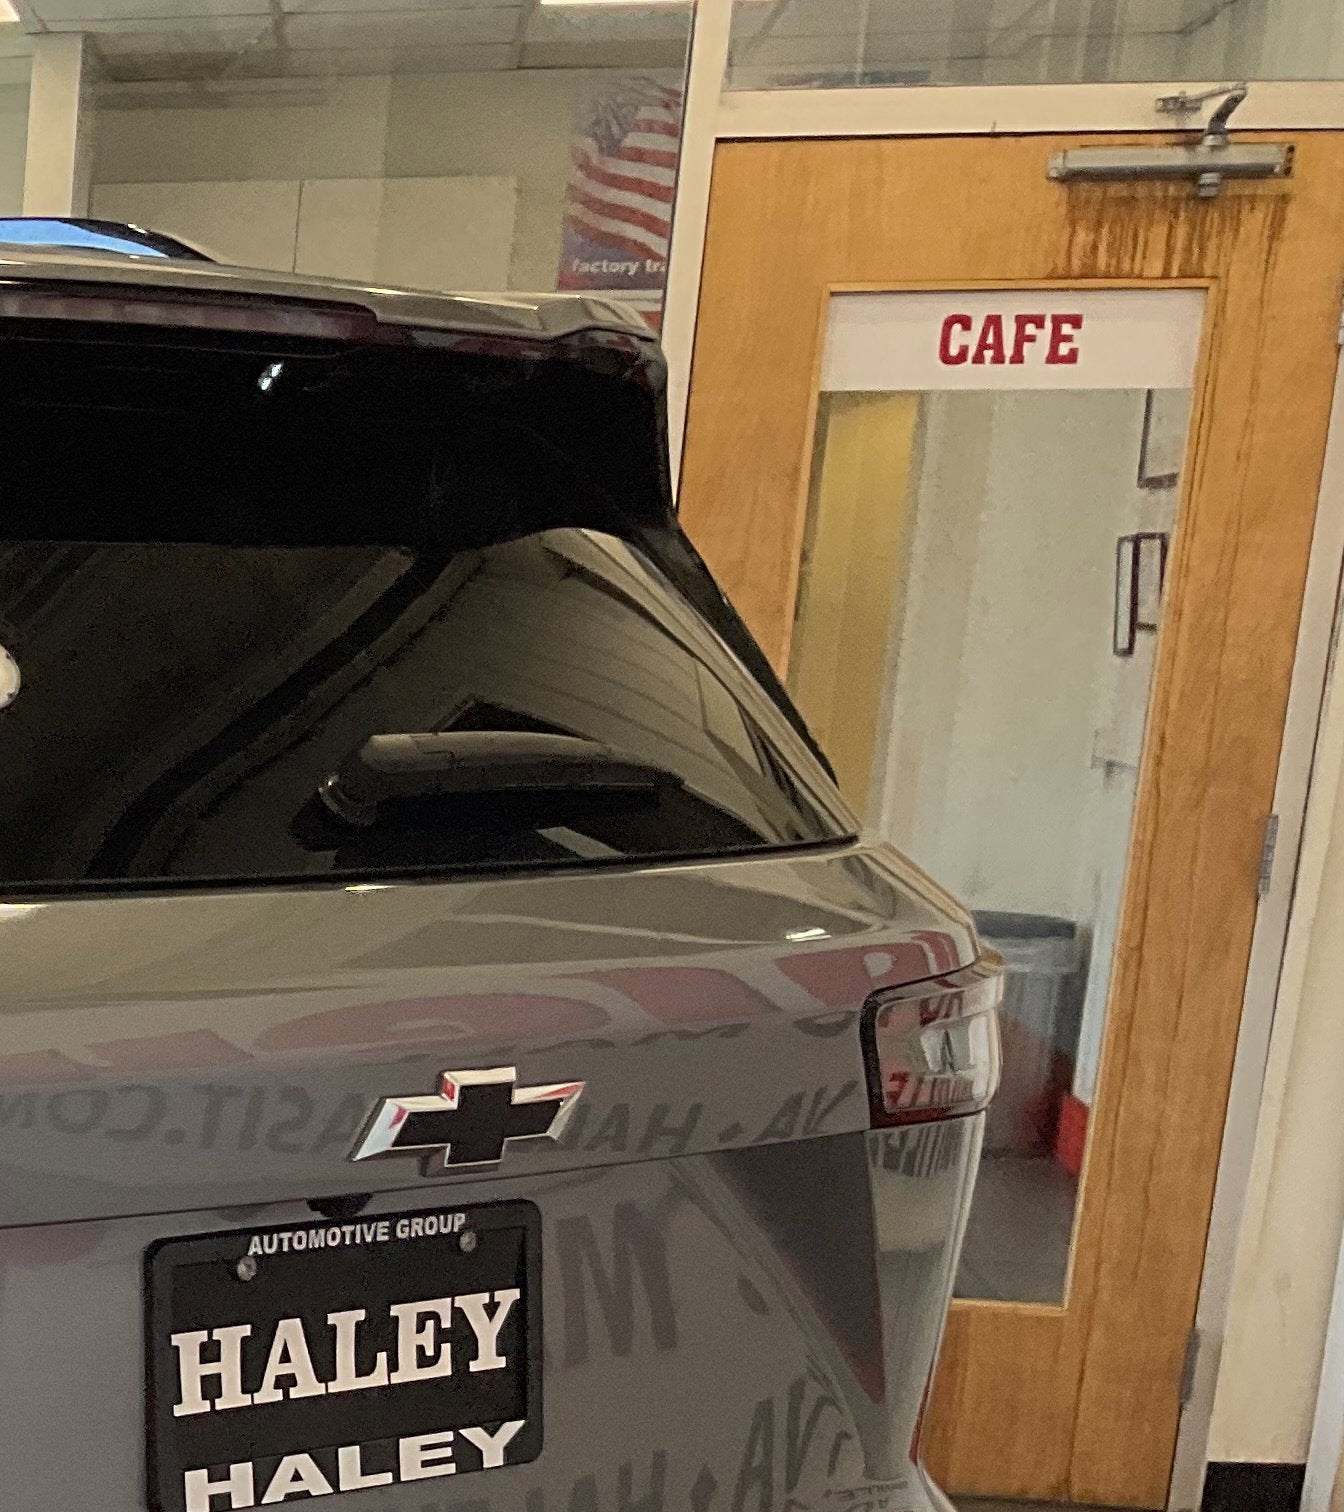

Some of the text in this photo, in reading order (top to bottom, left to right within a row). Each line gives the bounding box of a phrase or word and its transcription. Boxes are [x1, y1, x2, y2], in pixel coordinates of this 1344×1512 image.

[938, 313, 1084, 366] CAFE
[247, 1212, 467, 1256] AUTOMOTIVE GROUP
[170, 1287, 521, 1418] HALEY
